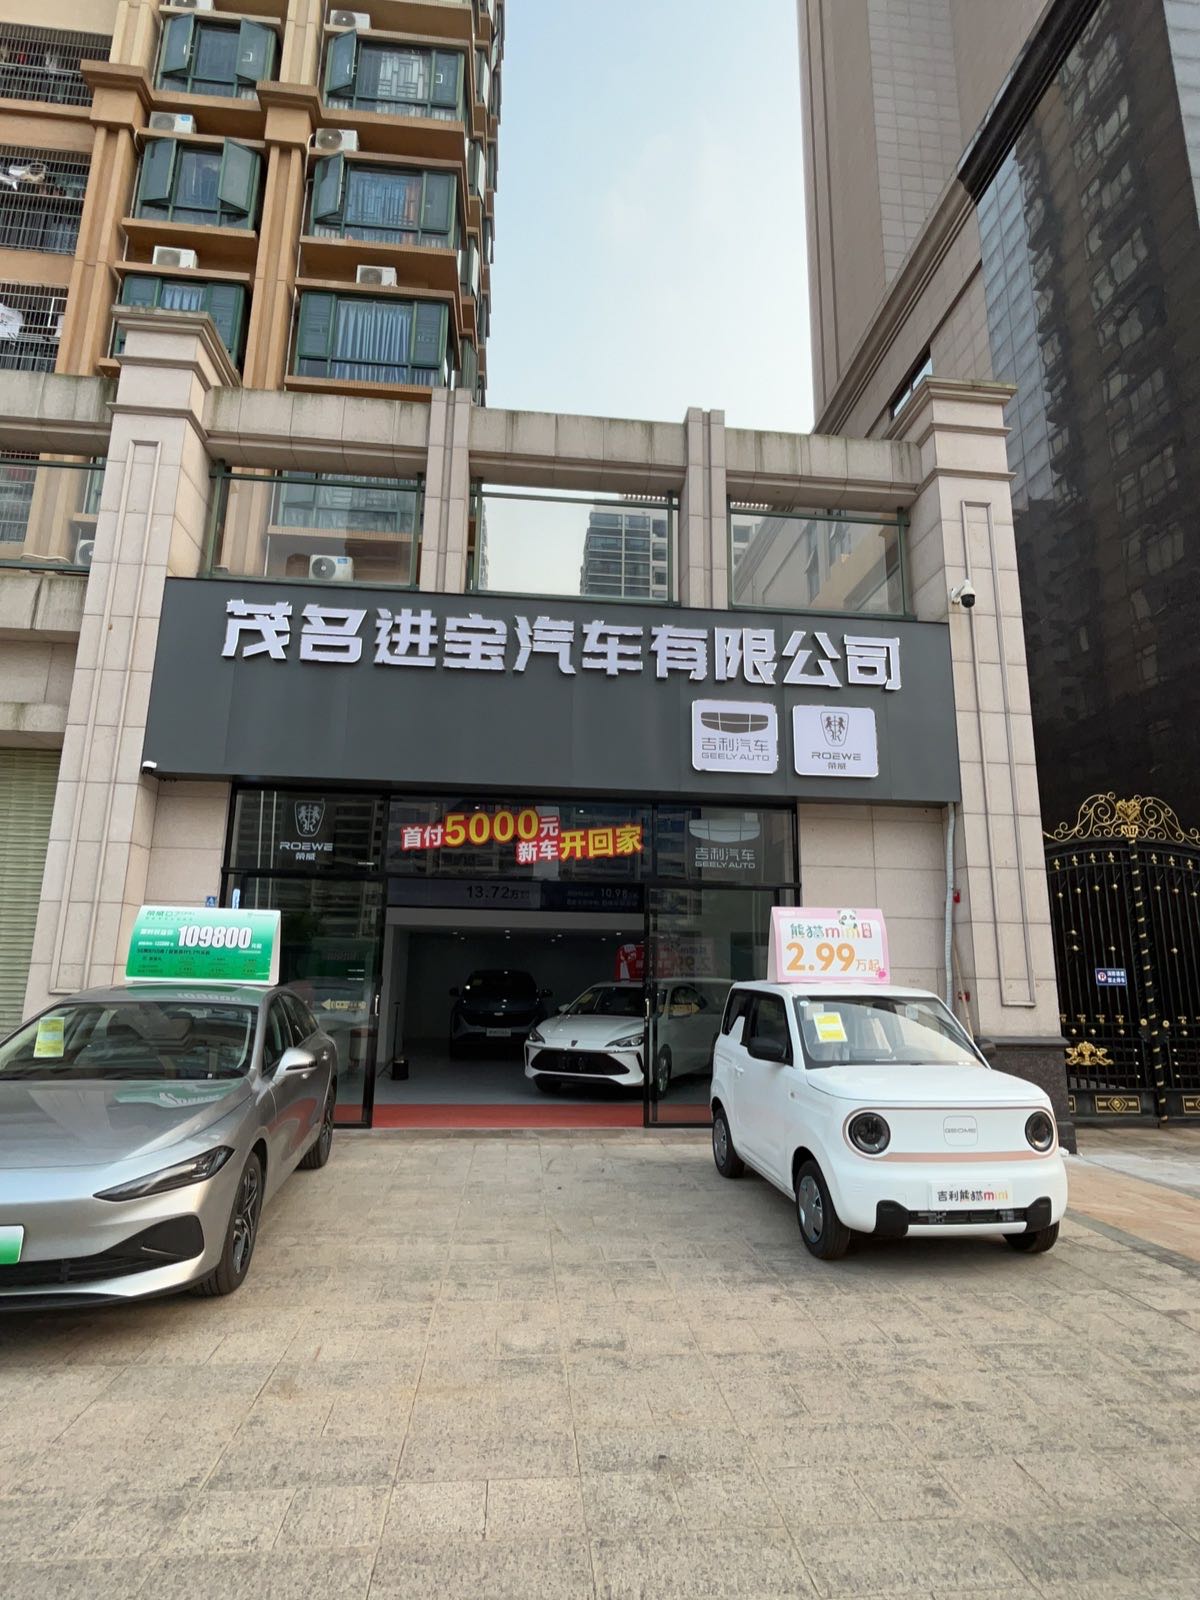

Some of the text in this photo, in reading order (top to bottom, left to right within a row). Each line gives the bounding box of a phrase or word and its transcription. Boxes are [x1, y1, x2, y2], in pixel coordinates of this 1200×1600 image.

[221, 599, 902, 691] 茂名进宝汽车有限公司
[701, 736, 770, 752] 吉利汽车
[701, 752, 770, 762] GEELY AUTO
[811, 751, 862, 761] ROEWE
[827, 761, 847, 771] 荣威
[402, 809, 560, 849] 首付5000元
[279, 841, 334, 852] ROEWE
[518, 823, 643, 862] 新车开回家
[295, 851, 316, 861] 荣威
[695, 847, 756, 861] 吉利汽车
[694, 860, 756, 869] GEELY AUTO
[178, 925, 252, 949] 109800
[937, 1188, 1009, 1202] 吉利熊猫mini
